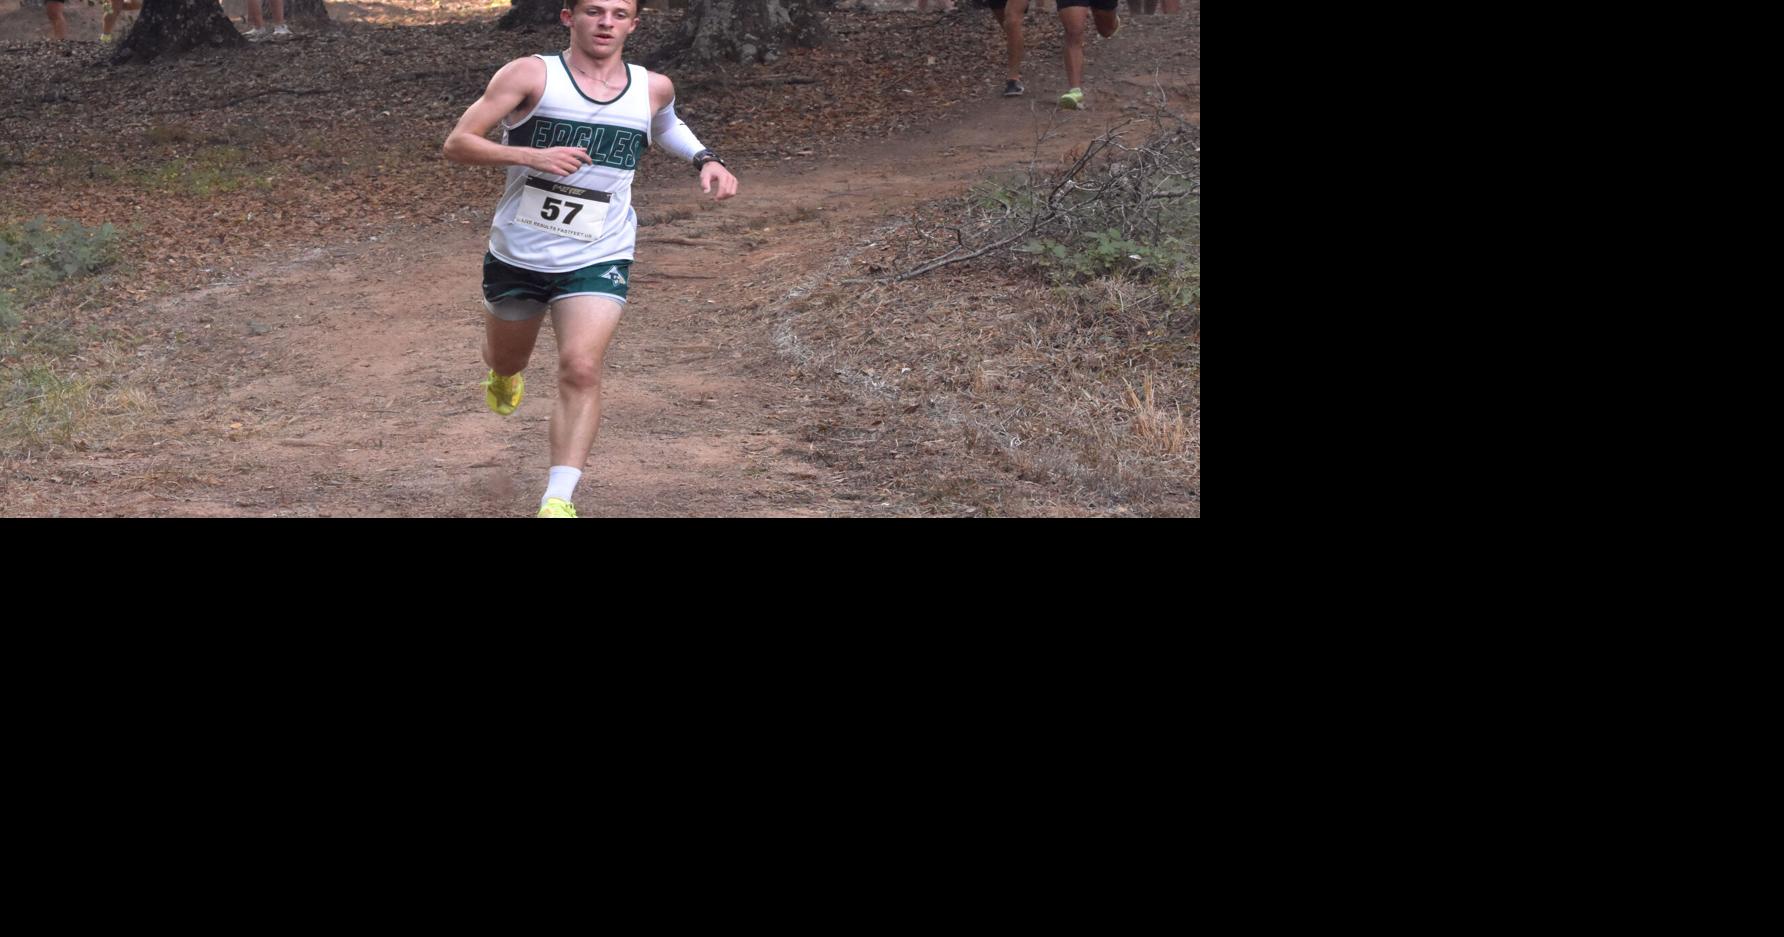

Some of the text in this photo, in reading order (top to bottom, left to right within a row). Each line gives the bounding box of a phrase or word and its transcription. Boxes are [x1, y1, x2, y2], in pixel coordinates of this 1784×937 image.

[531, 120, 642, 167] EAGLES
[540, 197, 584, 225] 57
[533, 221, 557, 231] RESULTS
